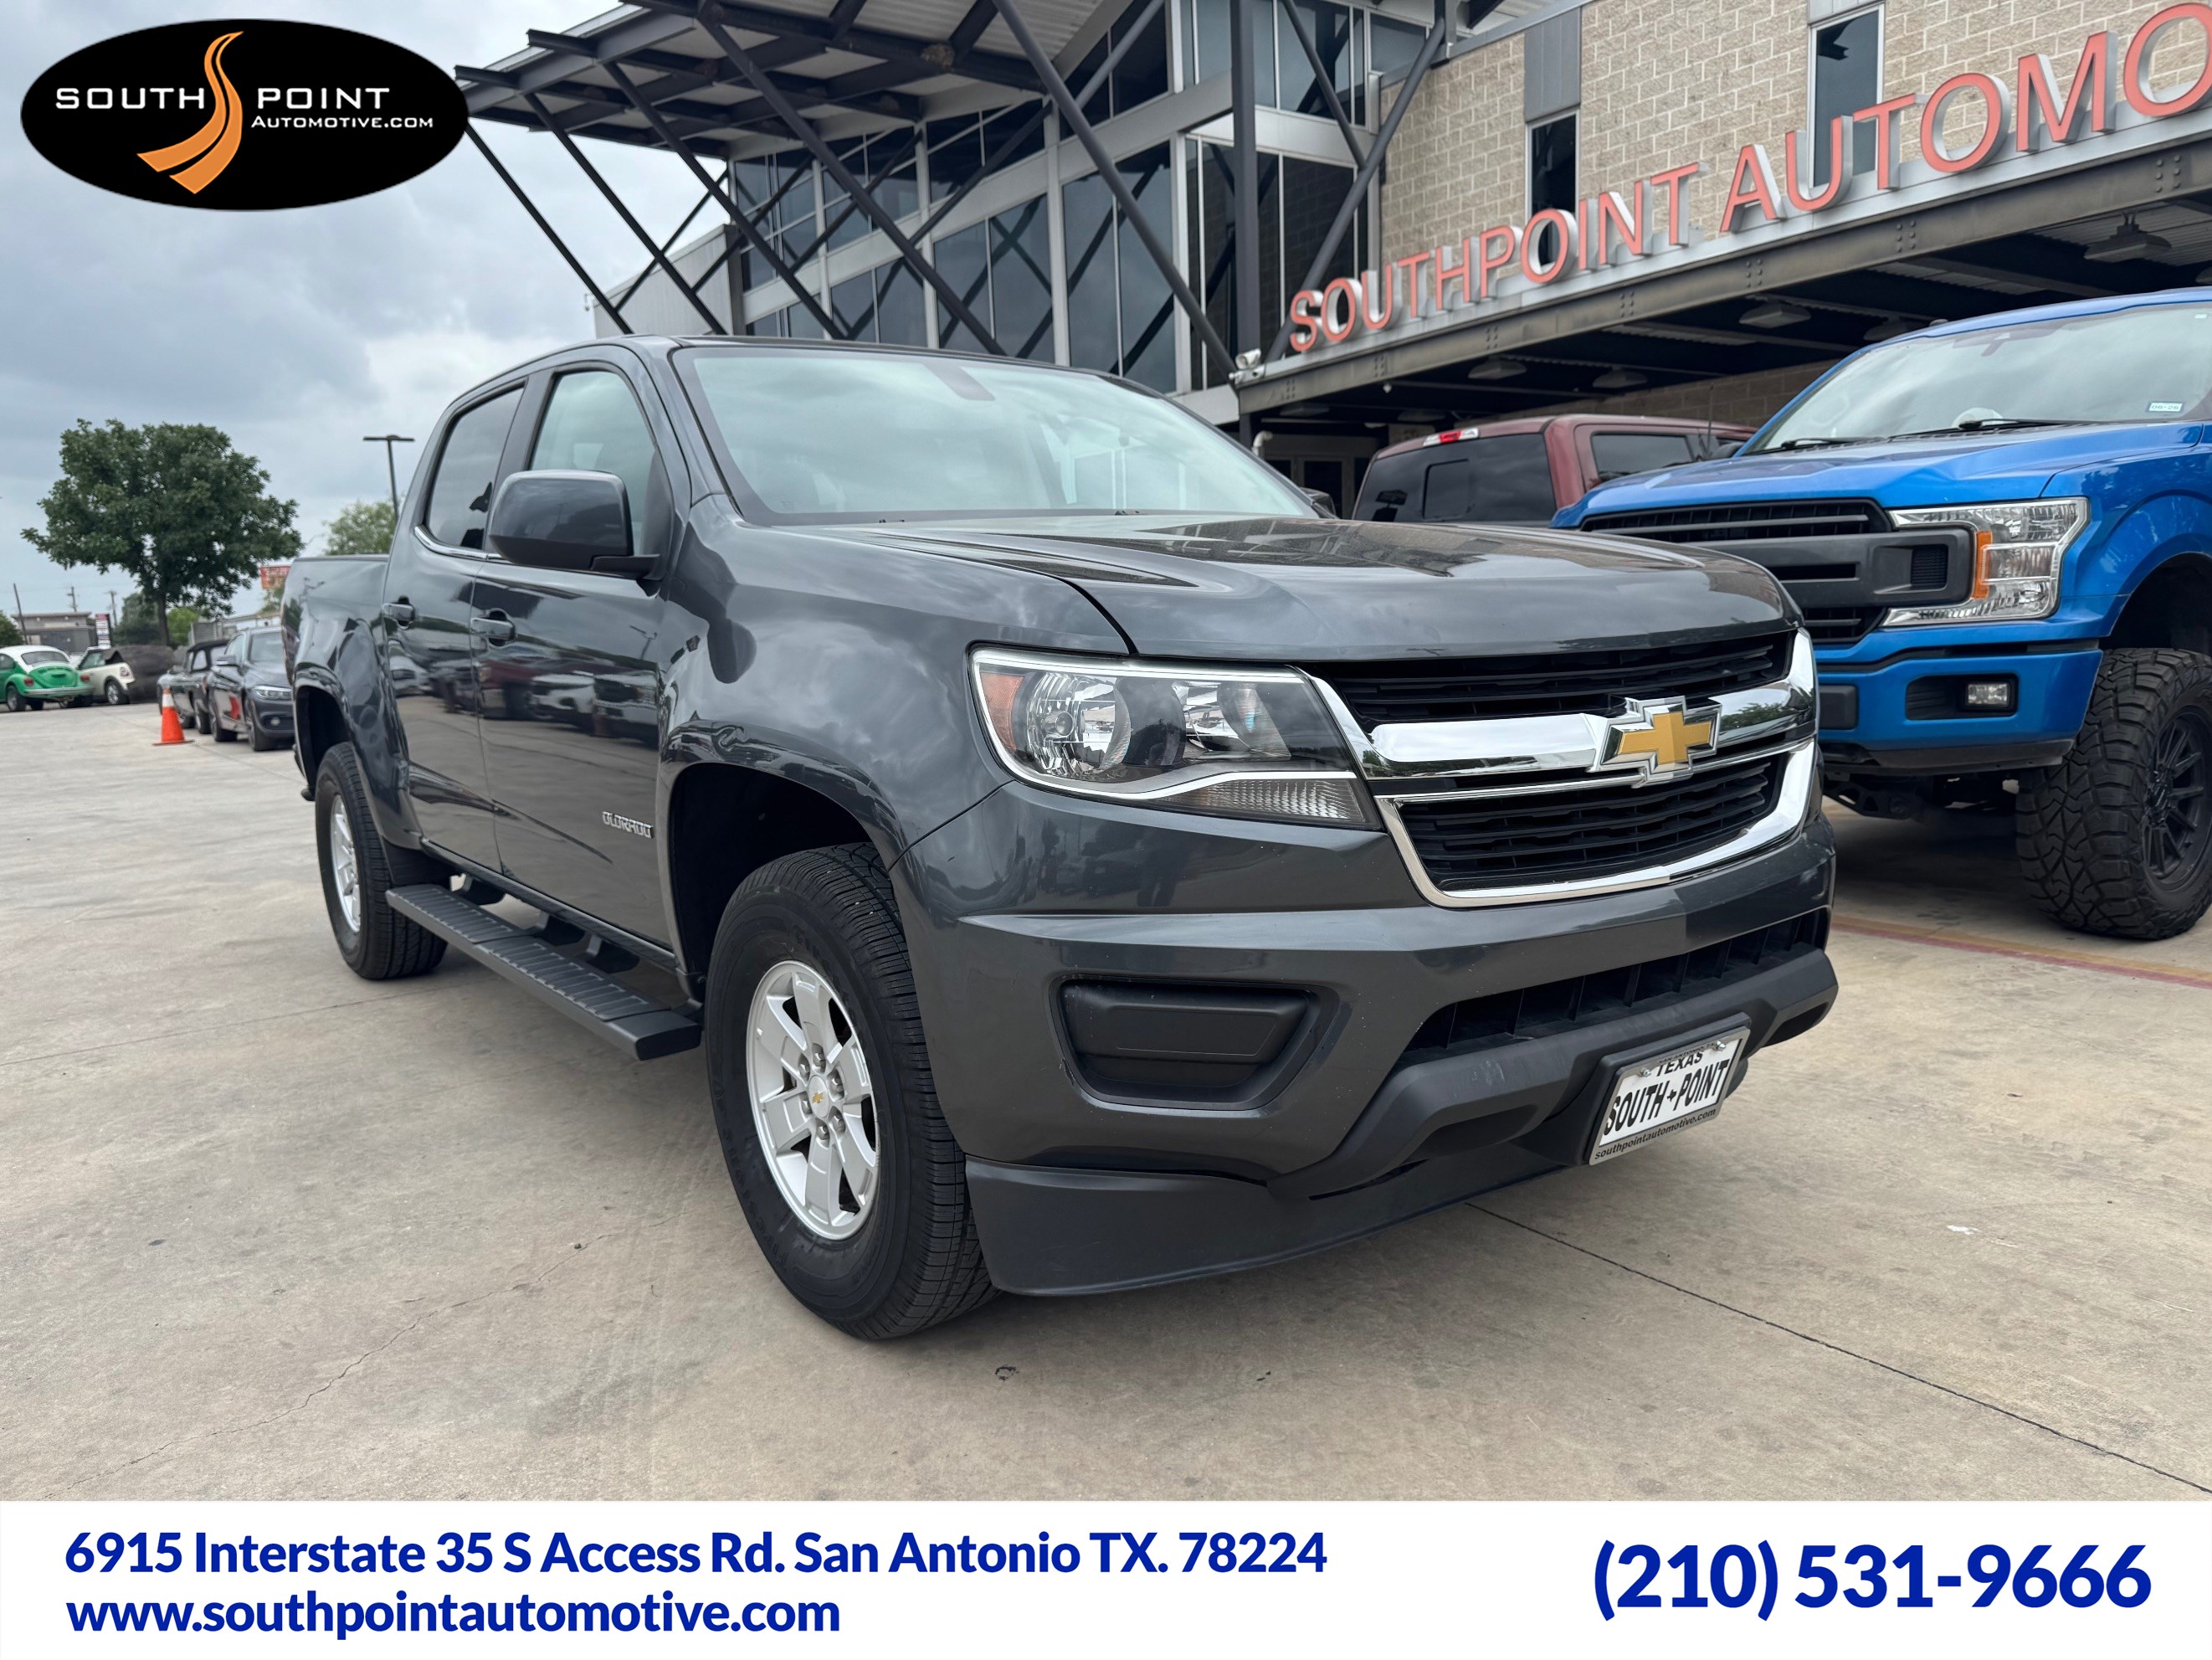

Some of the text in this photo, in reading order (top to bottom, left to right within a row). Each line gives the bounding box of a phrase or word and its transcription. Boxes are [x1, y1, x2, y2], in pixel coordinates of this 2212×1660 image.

[1289, 162, 1704, 353] SOUTHPOINT
[1594, 1109, 1717, 1159] southpointautomotive.com
[1604, 1059, 1730, 1135] SOUTH POINT
